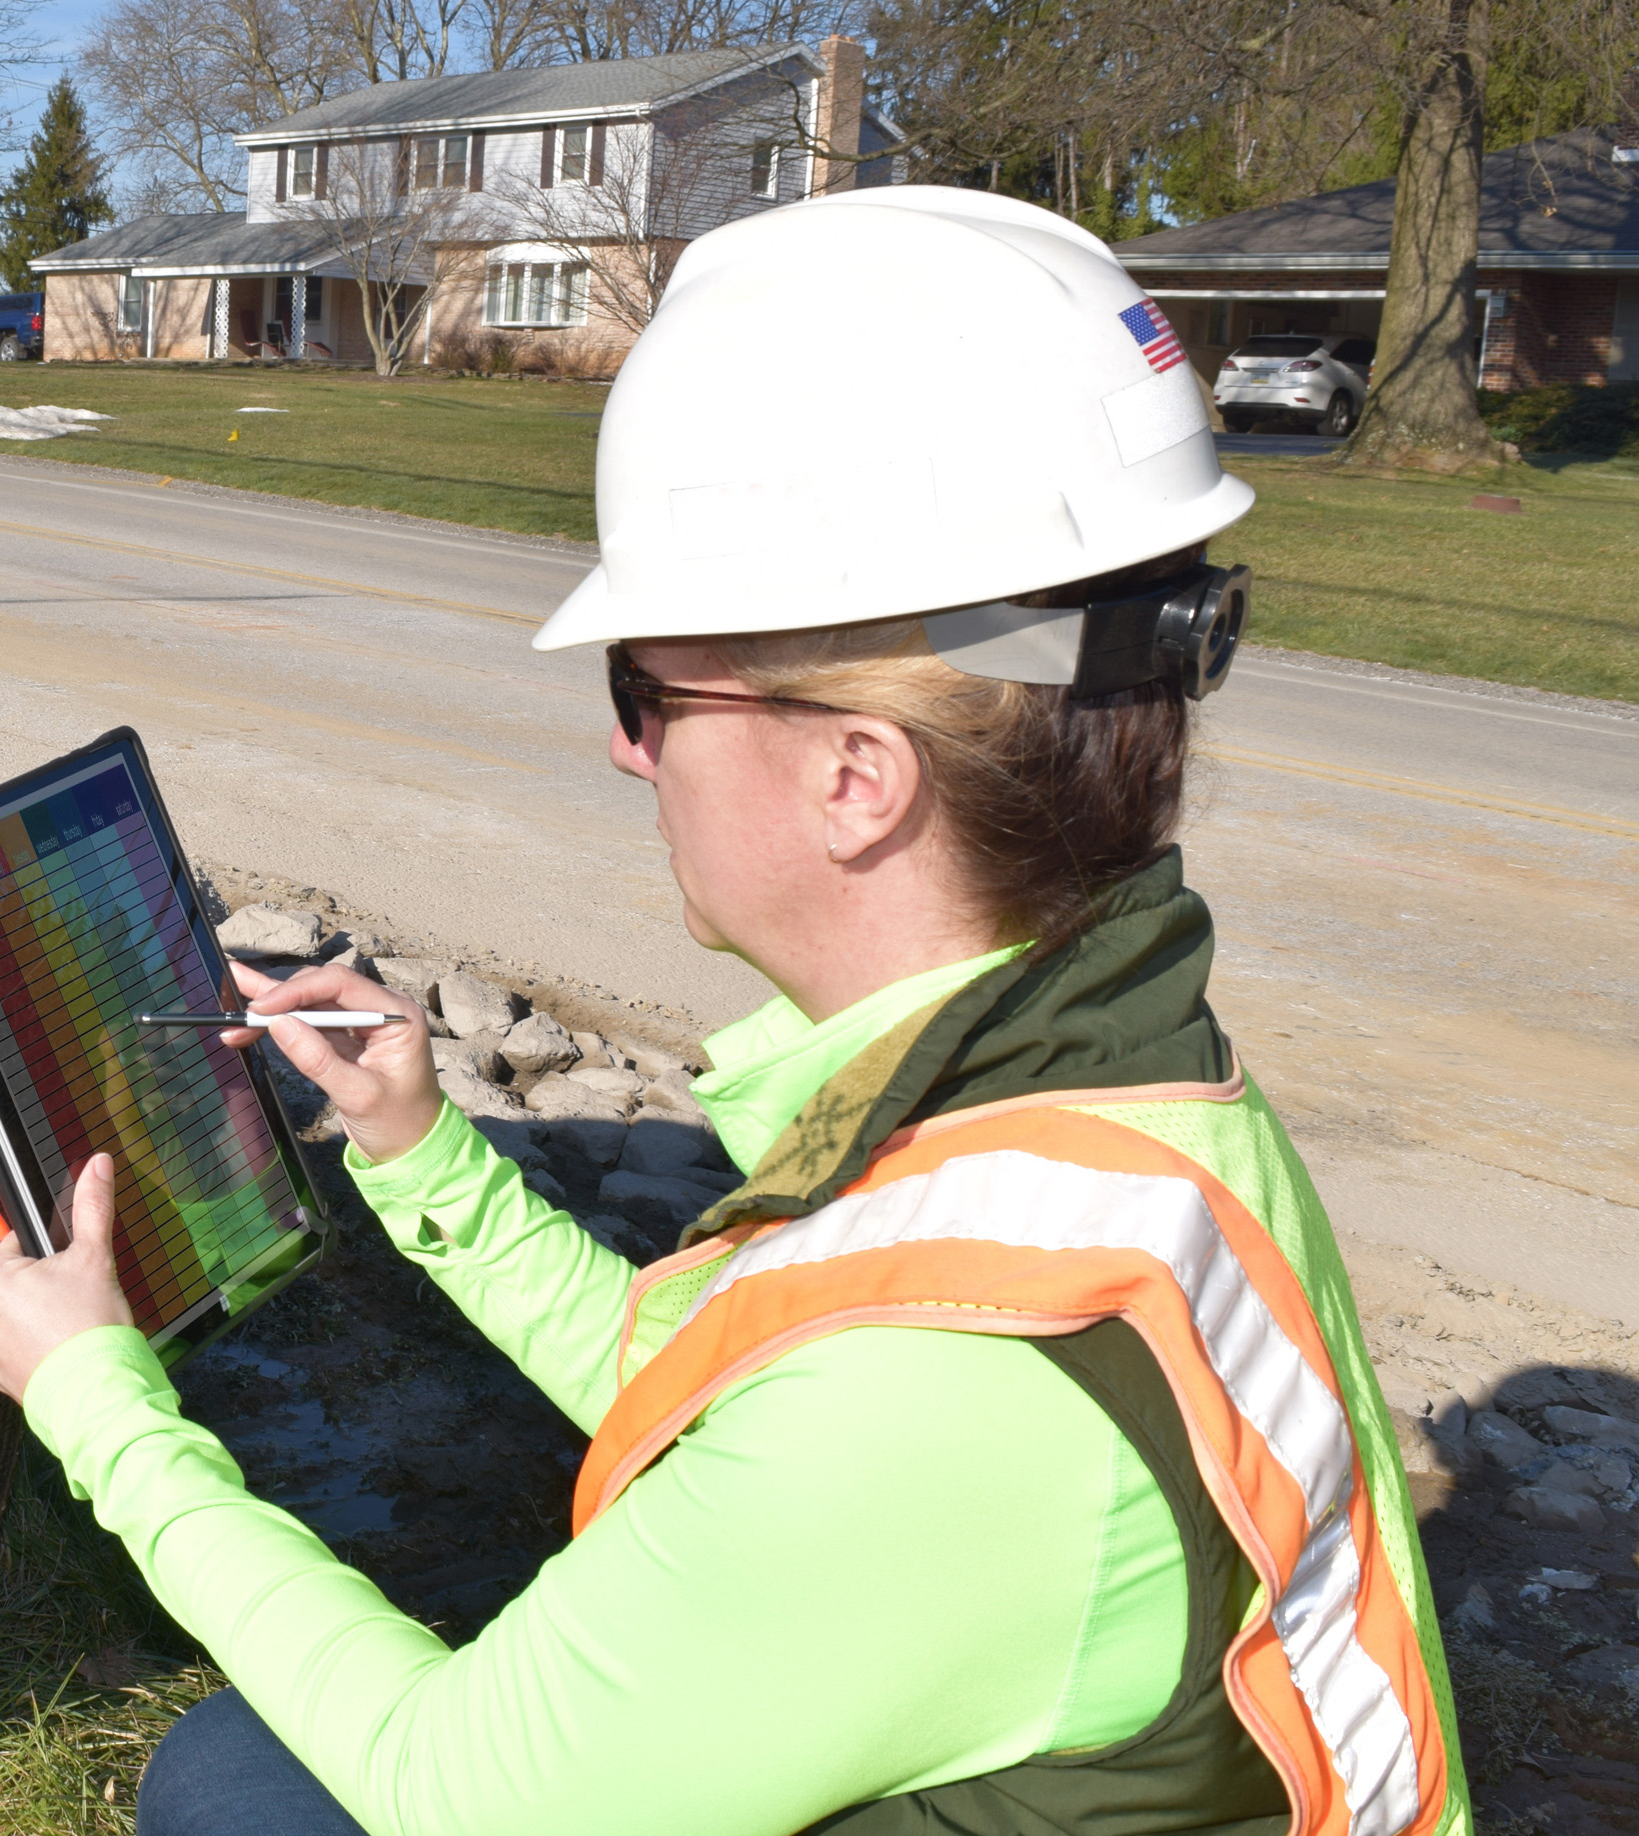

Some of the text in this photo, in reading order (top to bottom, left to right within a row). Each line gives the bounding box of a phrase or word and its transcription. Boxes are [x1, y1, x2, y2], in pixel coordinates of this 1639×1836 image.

[115, 799, 133, 817] saturday
[63, 823, 82, 841] thursday
[36, 835, 59, 854] wednesday
